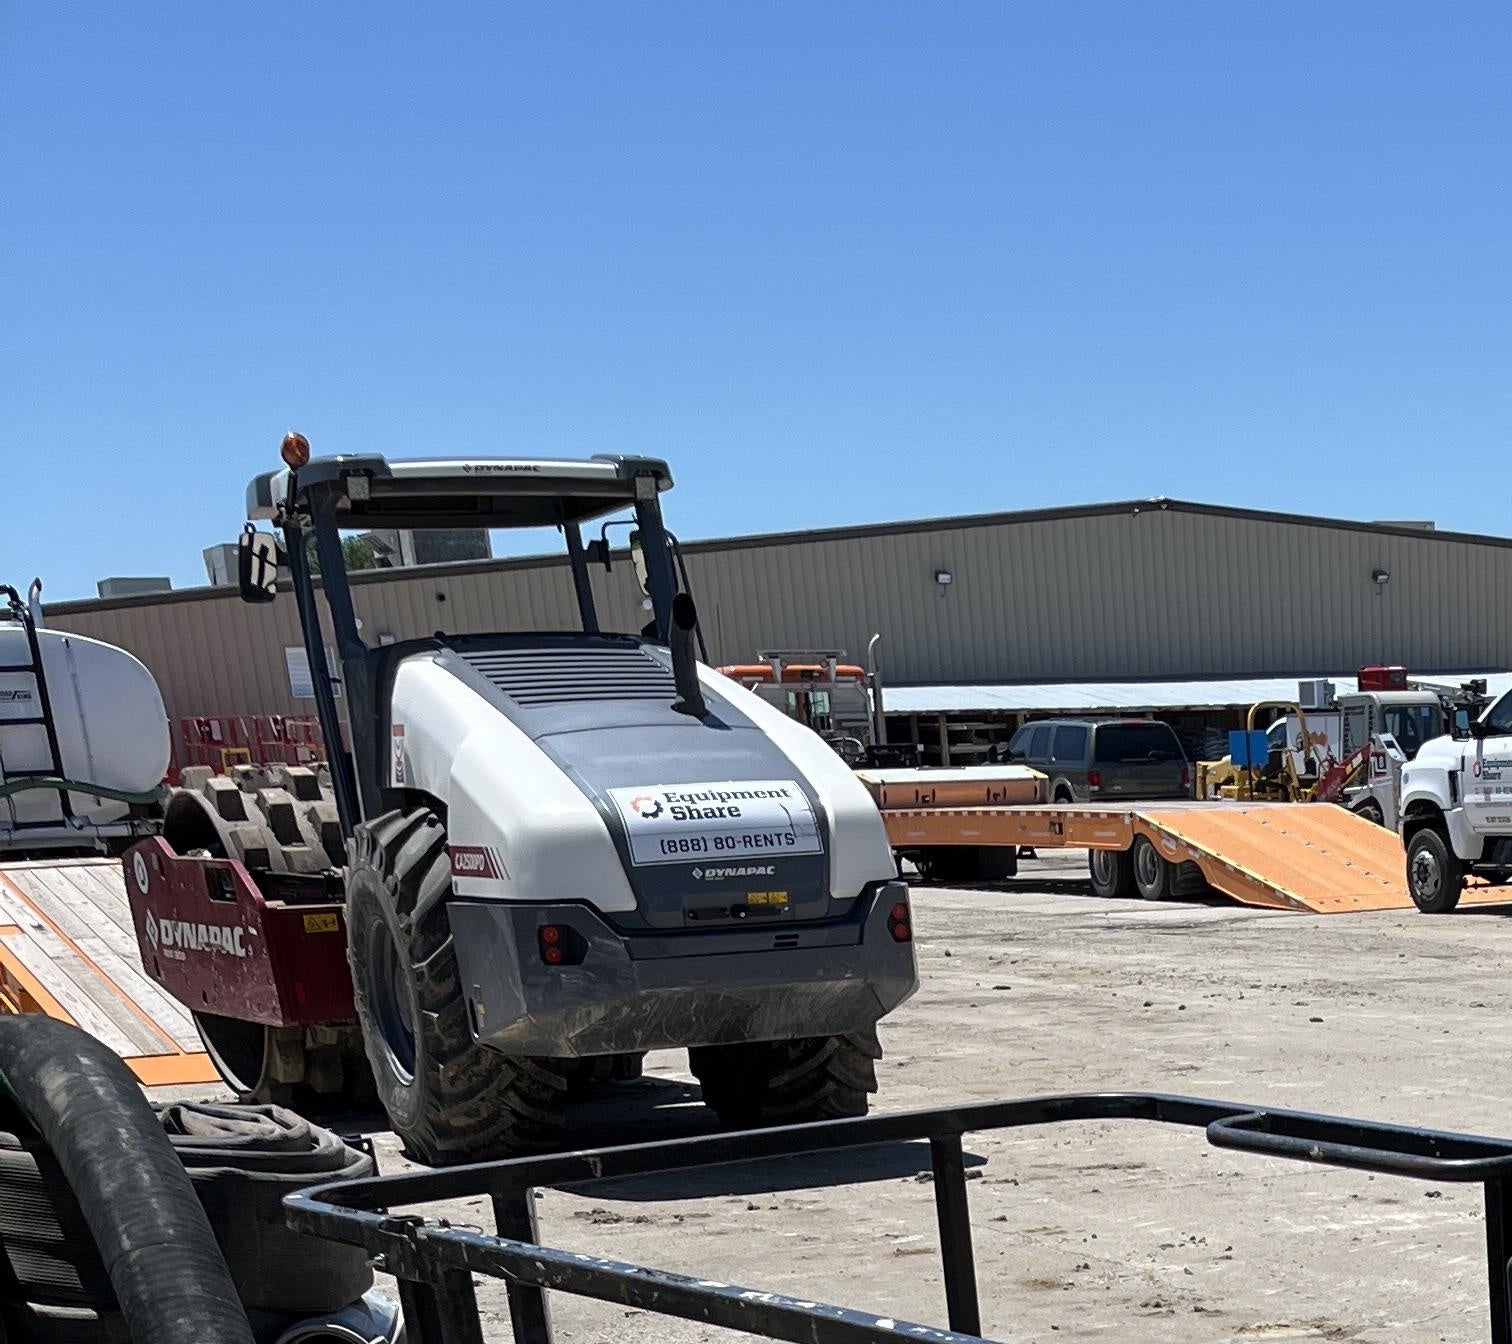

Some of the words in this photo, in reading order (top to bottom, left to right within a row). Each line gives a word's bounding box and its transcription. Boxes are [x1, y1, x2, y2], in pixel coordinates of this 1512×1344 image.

[662, 787, 791, 805] Equipment
[670, 805, 742, 821] Share
[661, 837, 708, 854] (888)
[714, 832, 796, 850] 80-RENTS
[705, 866, 776, 878] DYNAPAC
[159, 918, 246, 958] DYNAPAC
